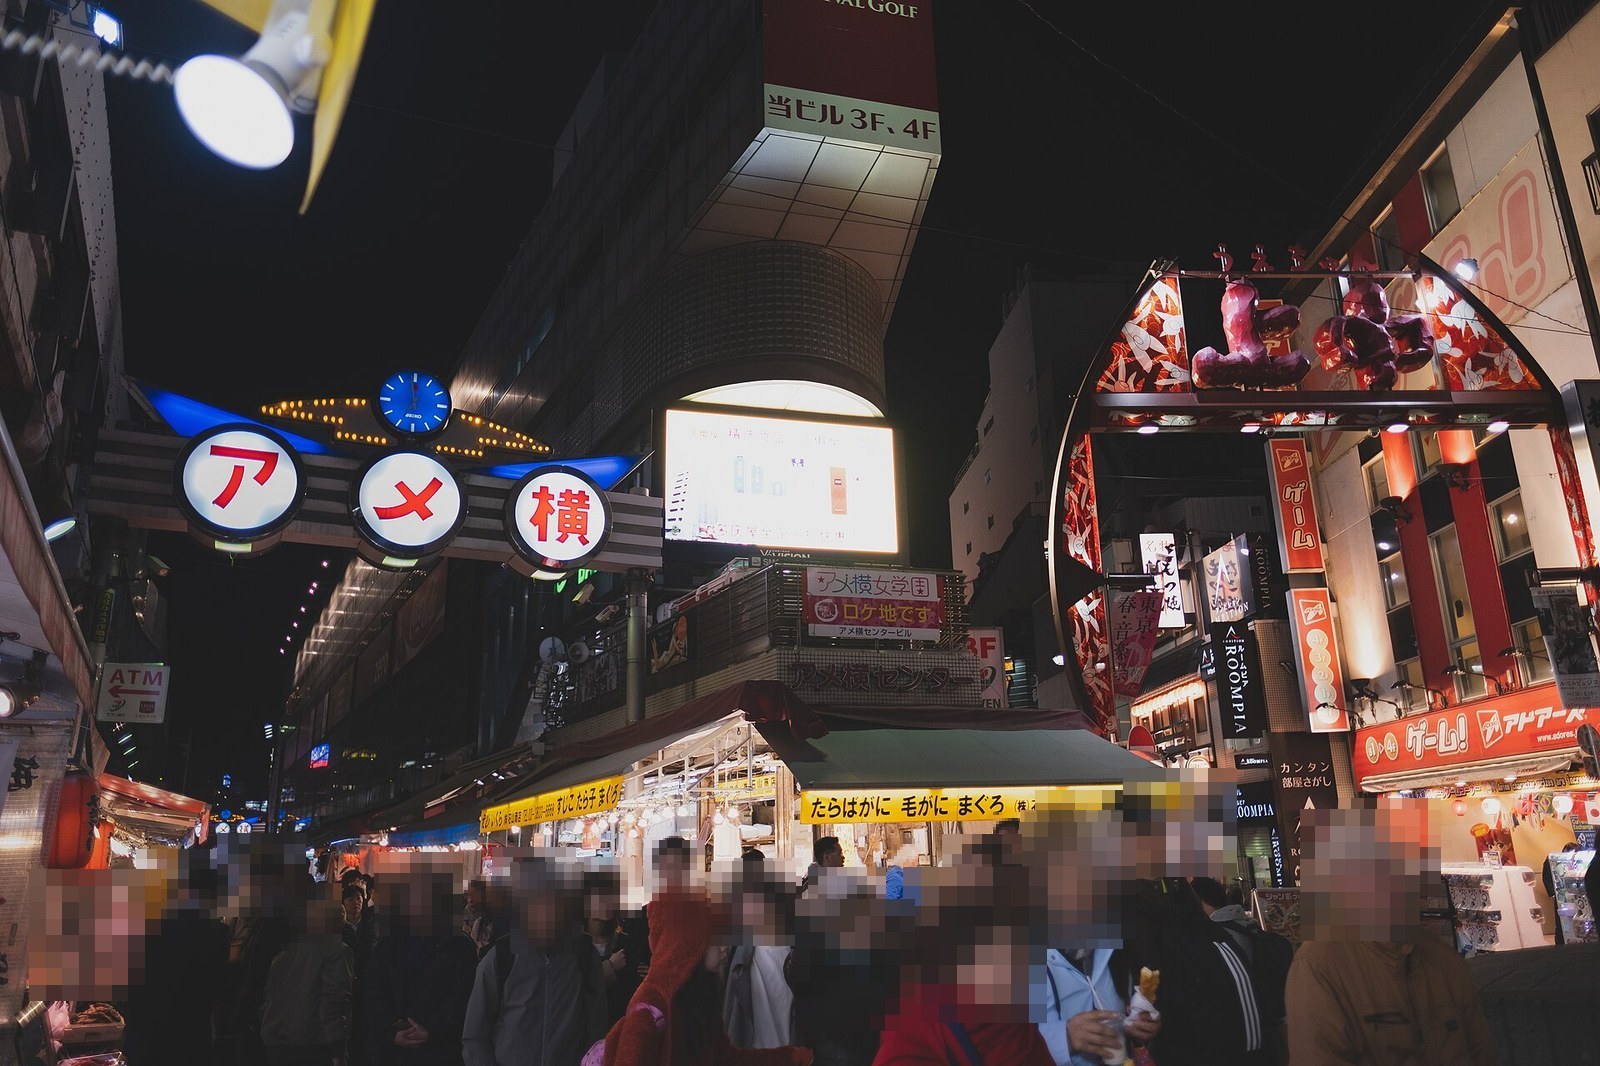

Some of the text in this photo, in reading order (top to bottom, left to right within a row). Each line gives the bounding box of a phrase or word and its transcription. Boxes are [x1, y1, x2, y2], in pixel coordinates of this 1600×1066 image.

[868, 0, 918, 19] GOLF
[768, 94, 843, 125] 当ビル
[1283, 481, 1317, 551] ゲーム
[817, 571, 930, 598] アメ横女学園
[1255, 548, 1271, 609] ROOMPIA
[843, 604, 931, 623] ロケ地です
[839, 626, 912, 638] アメ横センタービル
[109, 669, 163, 686] ATM
[790, 663, 975, 691] アメ横センター
[1225, 645, 1247, 733] ROOMPIA
[1406, 713, 1468, 760] ゲーム!
[1503, 705, 1587, 733] アドアーズ
[1280, 762, 1330, 774] カンタン
[1282, 776, 1332, 789] 部屋さがし
[810, 796, 891, 819] たらばがに
[901, 794, 949, 817] 毛がに
[958, 793, 1005, 816] まぐろ
[1237, 804, 1274, 818] OOMPIA
